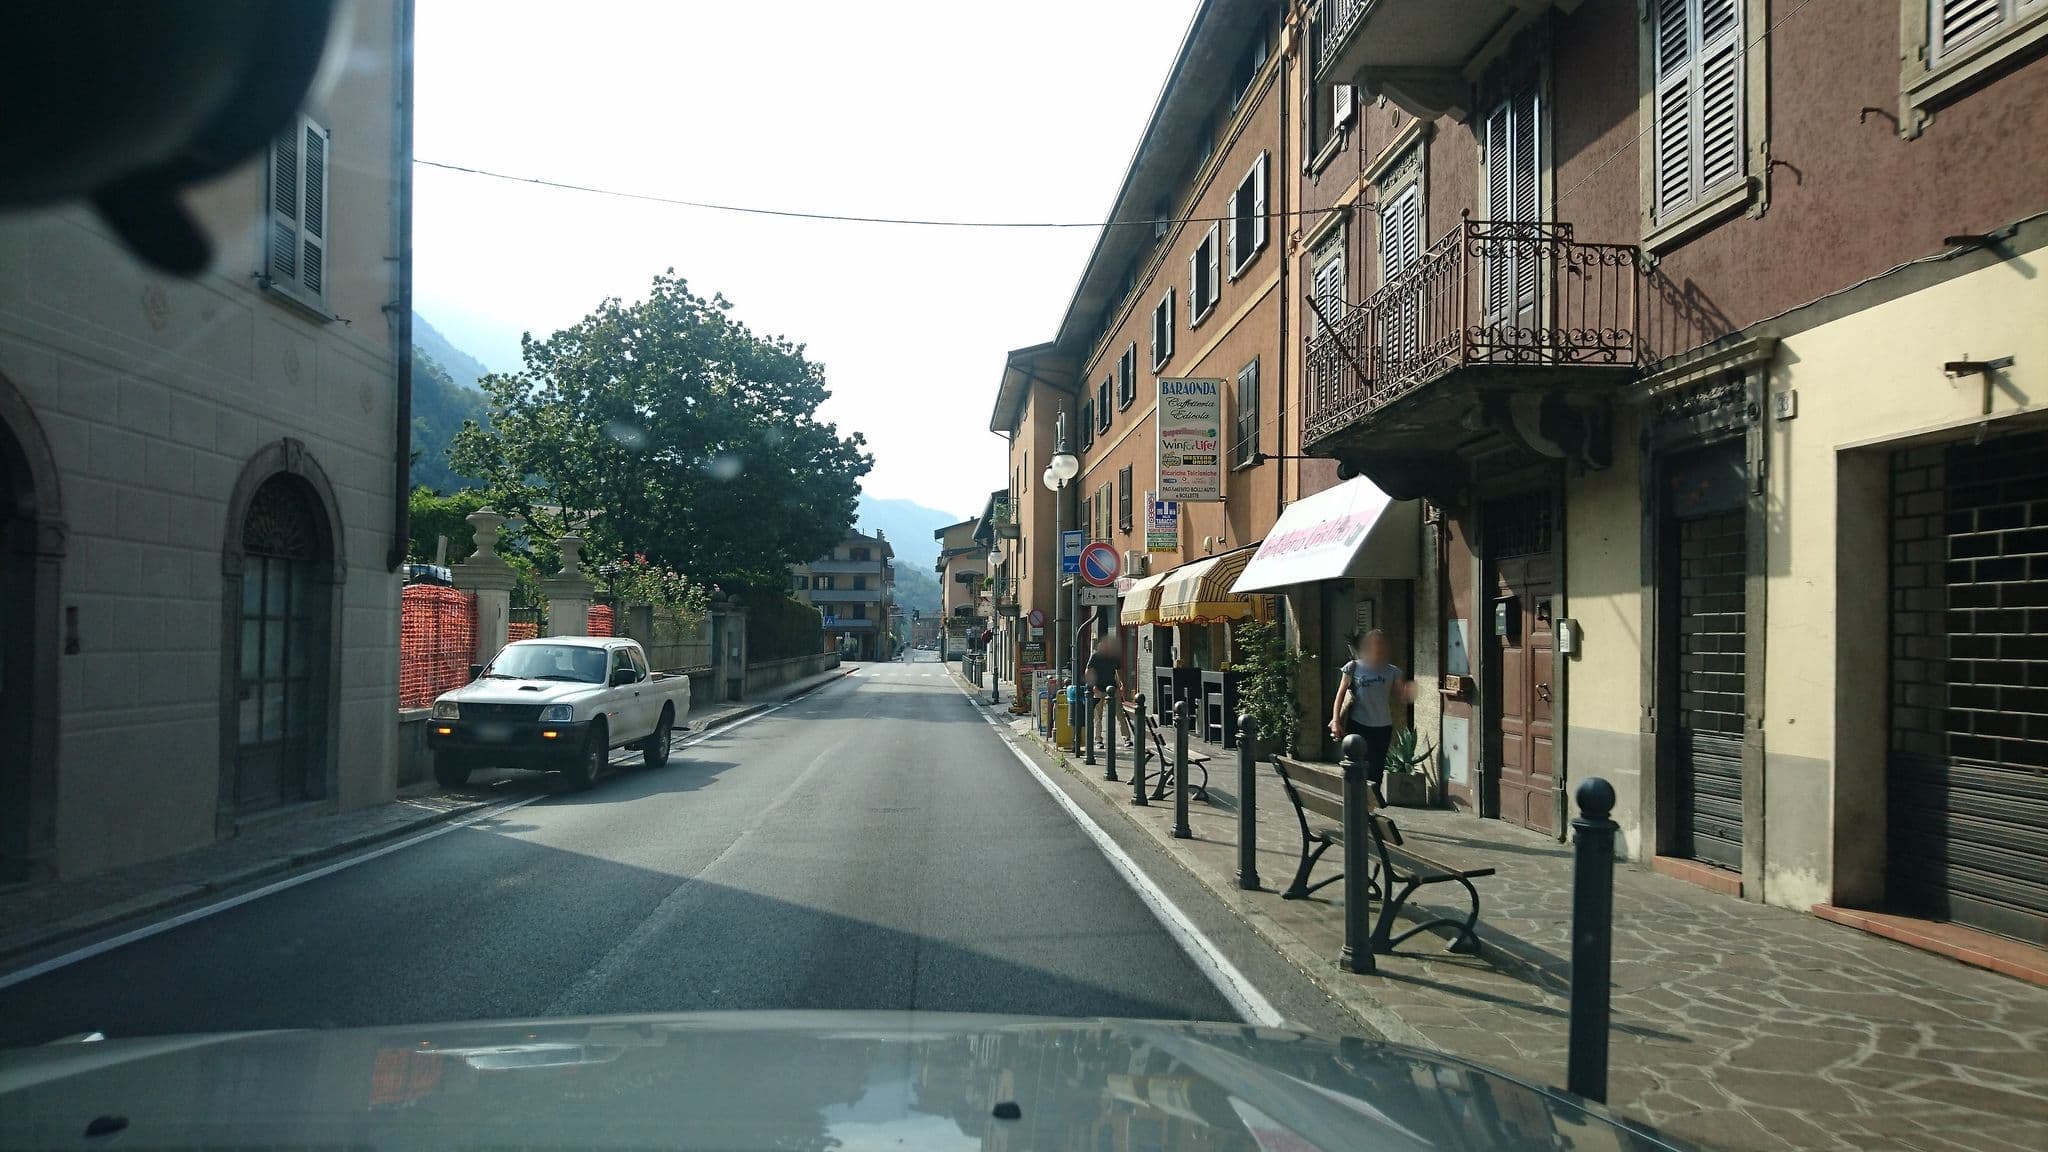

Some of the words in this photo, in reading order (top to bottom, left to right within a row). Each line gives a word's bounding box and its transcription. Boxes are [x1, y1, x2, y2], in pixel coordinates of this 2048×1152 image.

[1162, 381, 1217, 395] BARAONDA
[1165, 396, 1215, 409] Caffetteria
[1170, 409, 1210, 420] Edicola
